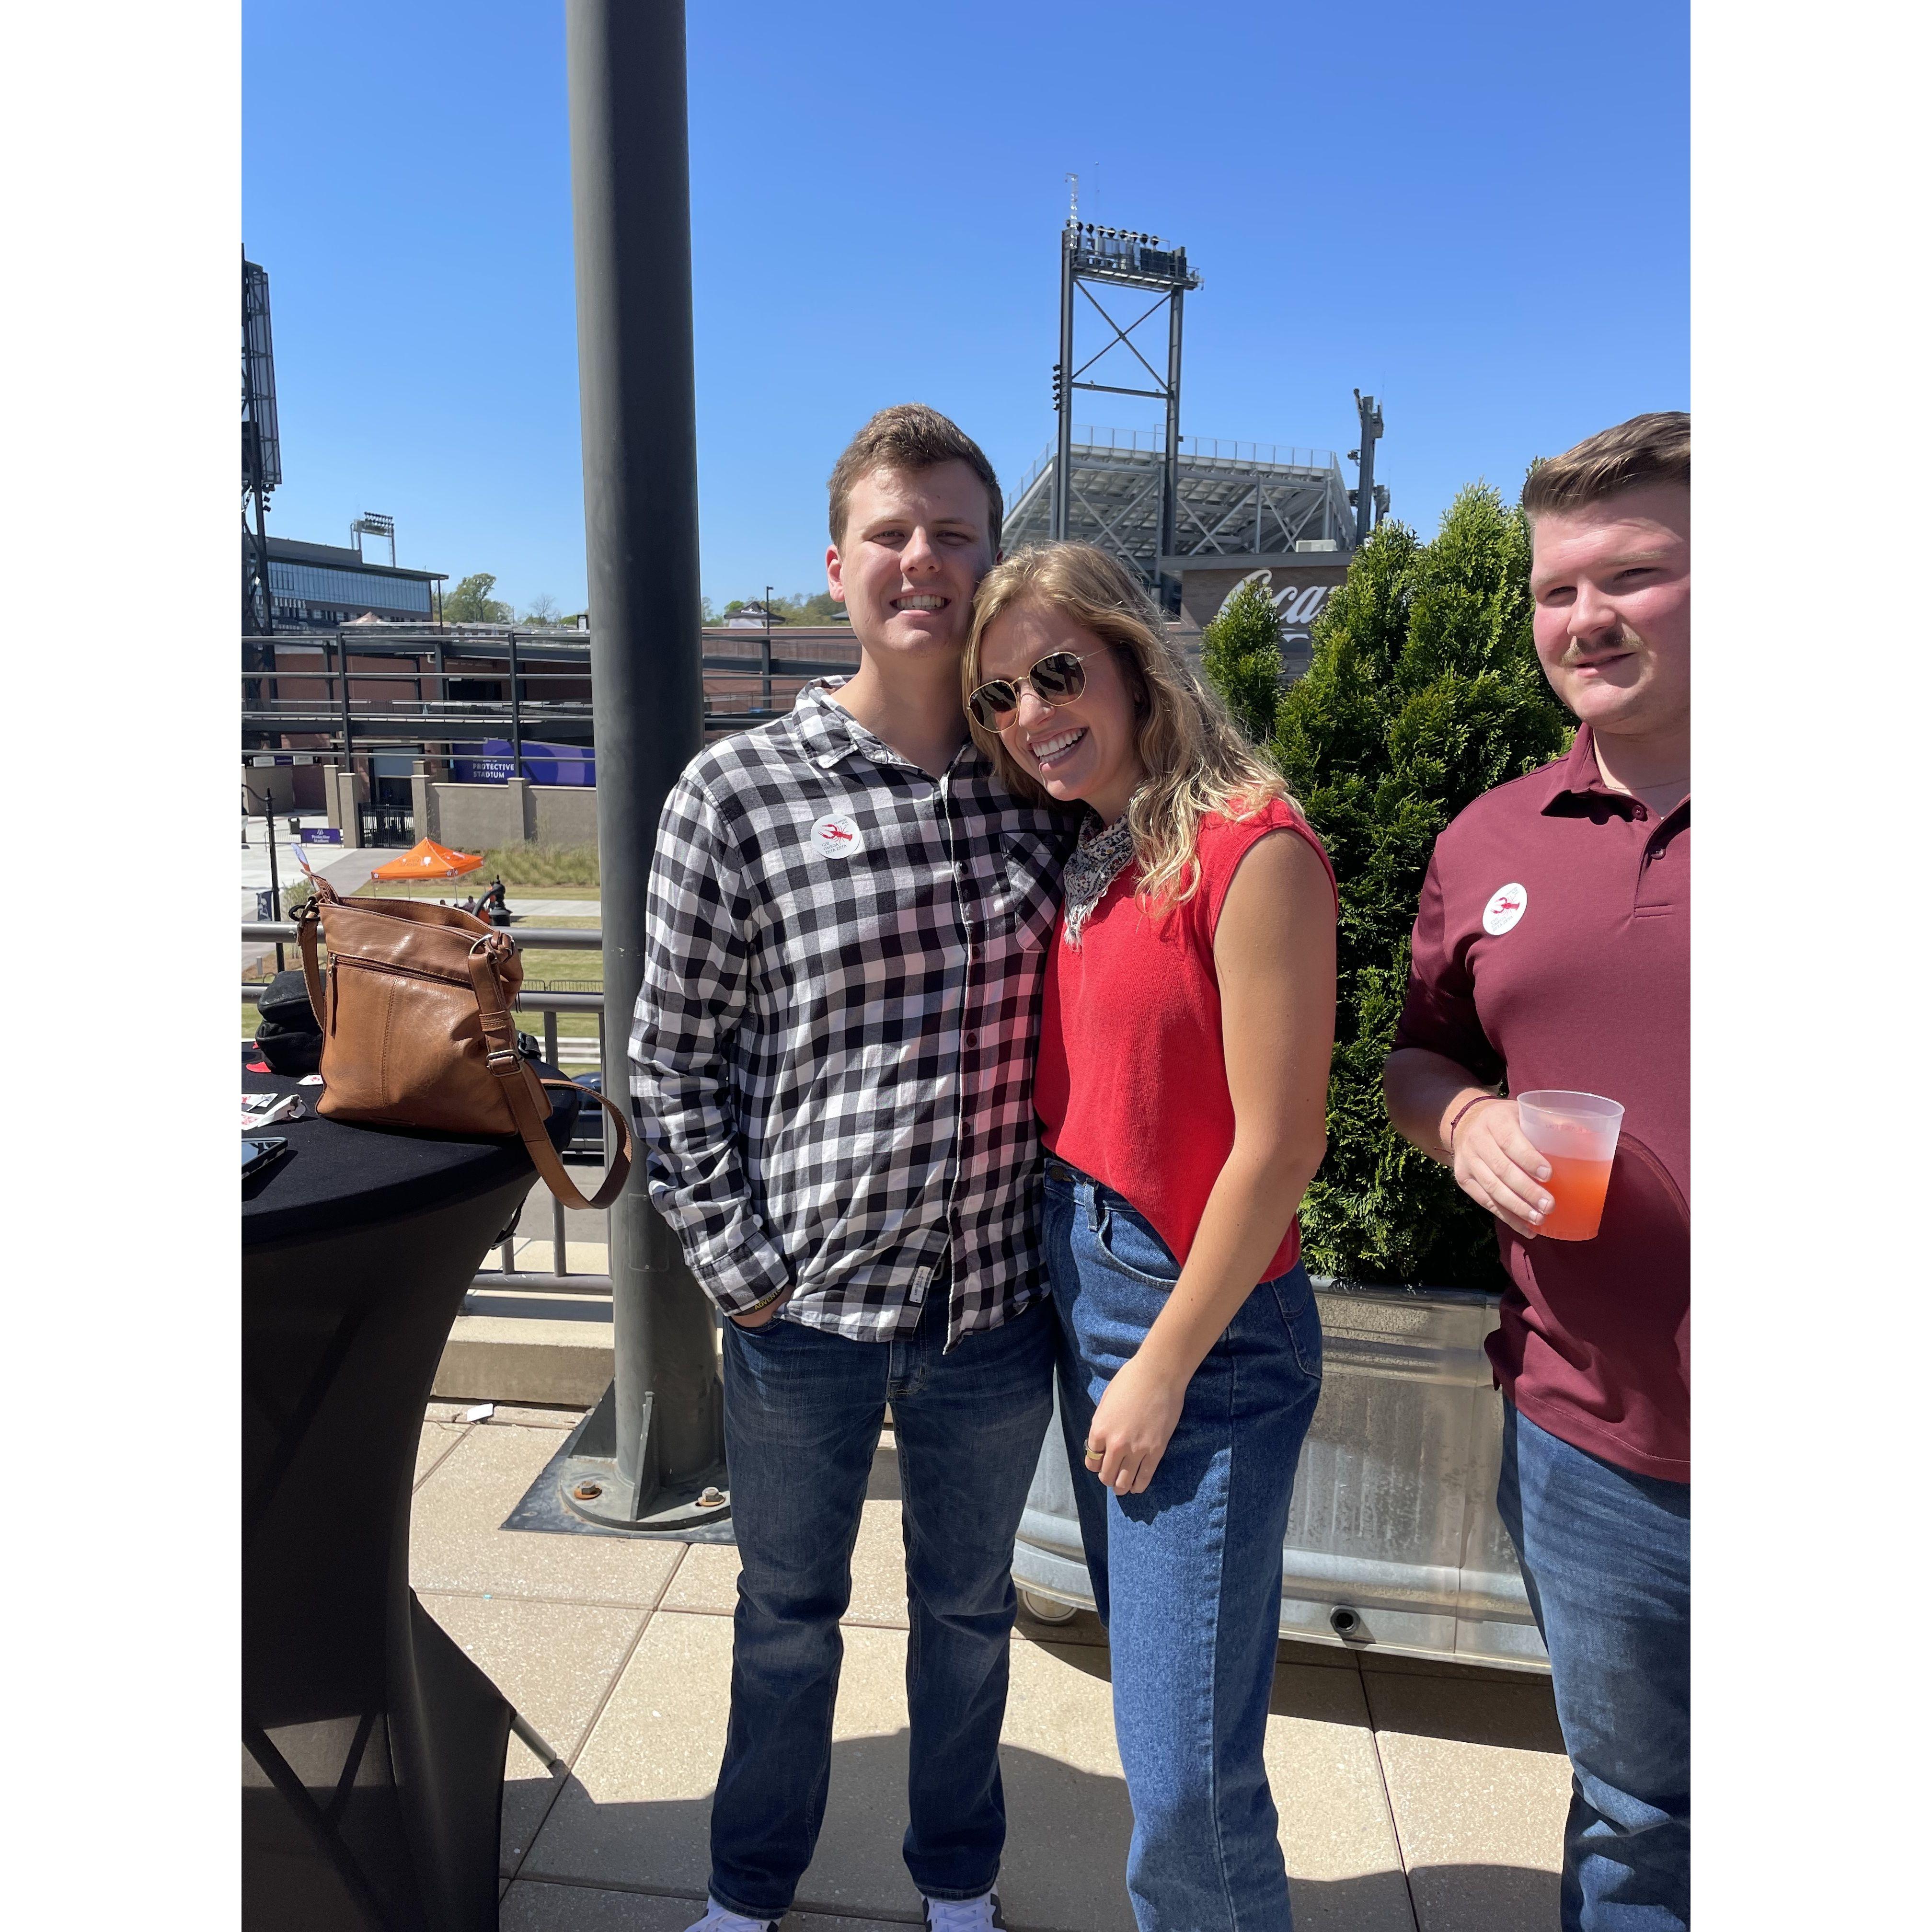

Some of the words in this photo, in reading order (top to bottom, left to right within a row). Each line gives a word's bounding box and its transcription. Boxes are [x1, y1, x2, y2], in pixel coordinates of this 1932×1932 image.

[1216, 569, 1328, 624] Cca
[472, 763, 515, 771] PROTECTIVE
[473, 770, 505, 779] STADIUM
